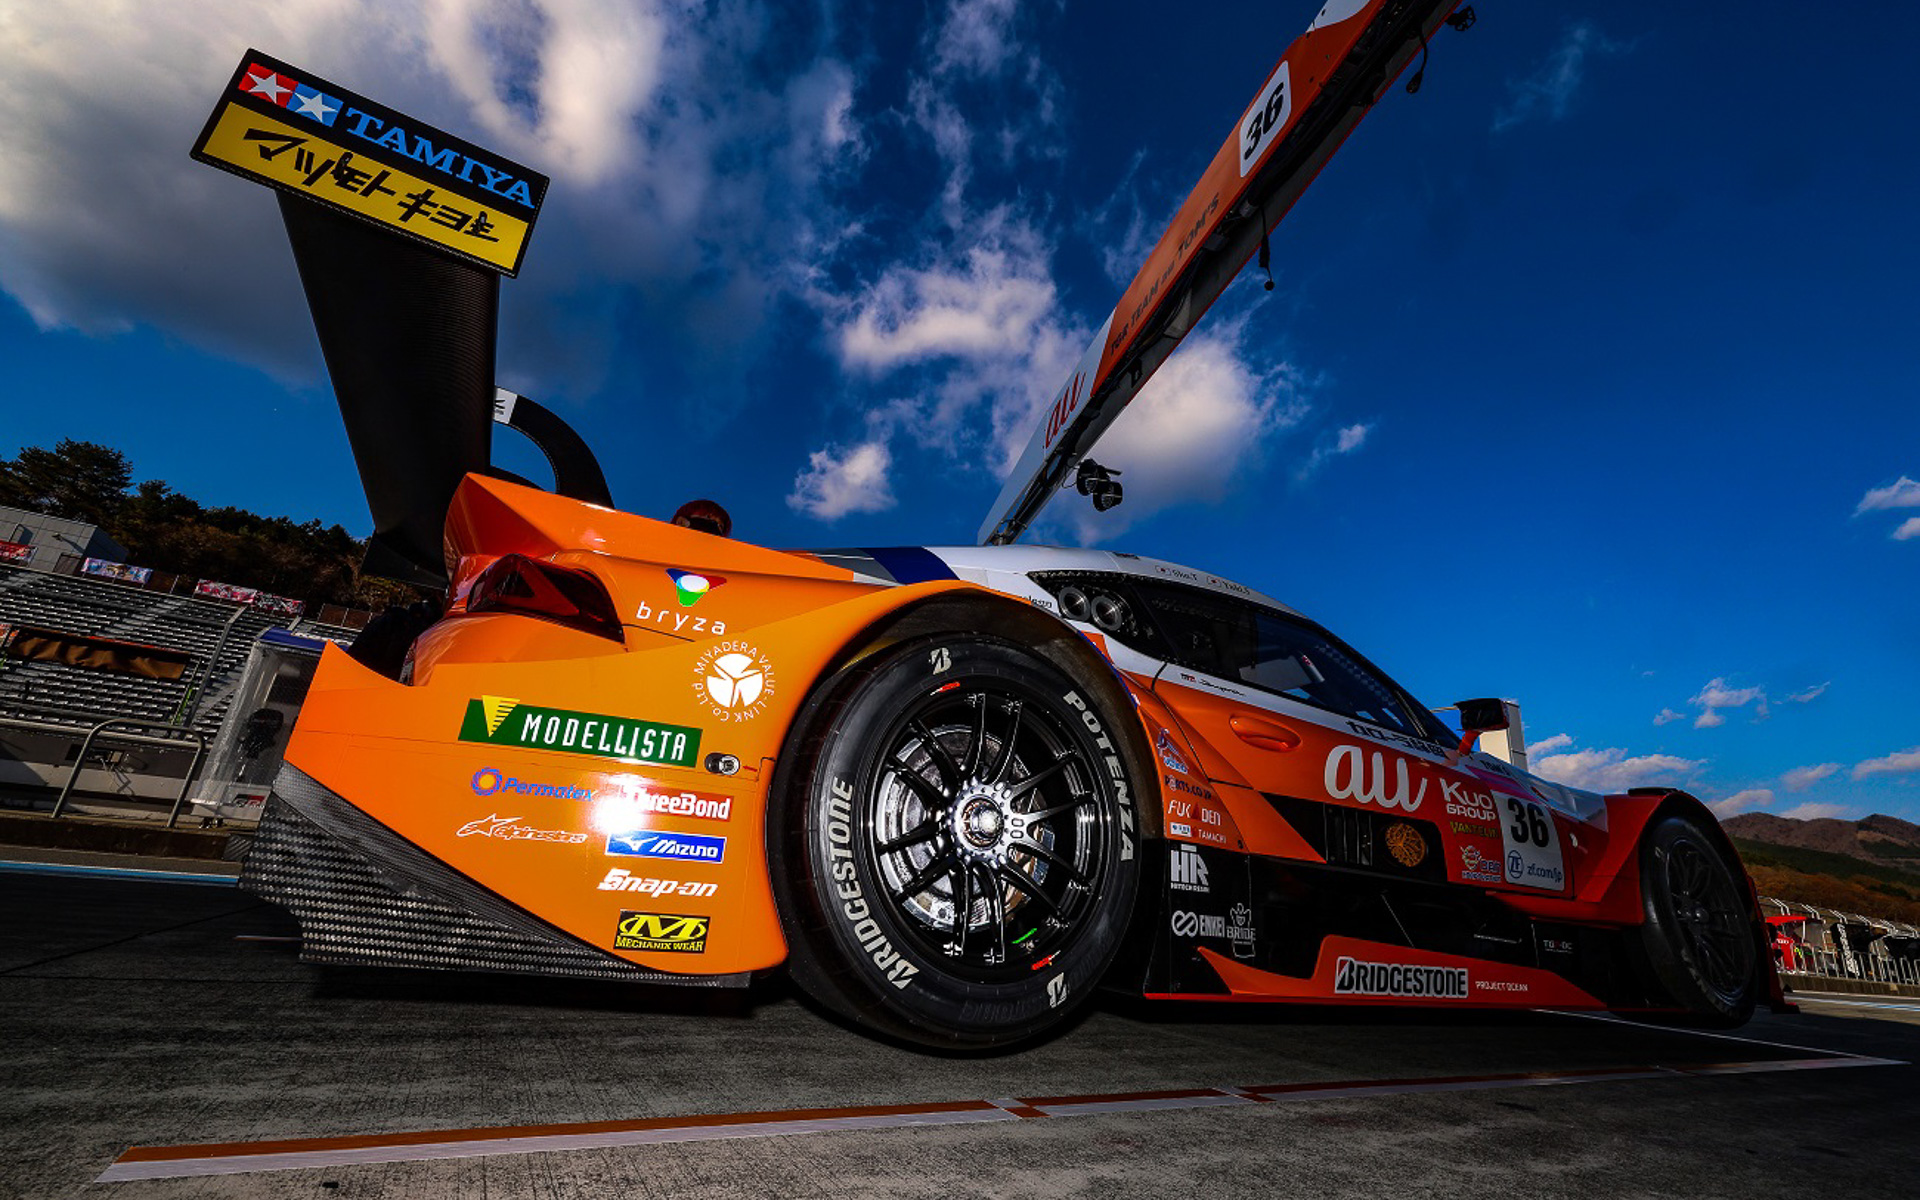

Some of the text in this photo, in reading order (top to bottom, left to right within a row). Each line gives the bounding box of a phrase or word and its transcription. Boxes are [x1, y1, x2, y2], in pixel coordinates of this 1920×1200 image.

[1243, 82, 1284, 160] 36
[345, 107, 536, 209] TAMIYA
[1130, 277, 1159, 327] TEAM
[1176, 192, 1220, 260] TOM'S
[1044, 371, 1087, 448] au
[635, 600, 727, 635] bryza
[693, 640, 757, 676] MIYADERA
[520, 713, 688, 762] MODELLISTA
[501, 777, 597, 802] Permatex
[1063, 690, 1134, 862] POTENZA
[1324, 744, 1428, 813] au
[623, 786, 731, 820] hreeBond
[1446, 803, 1496, 821] GROUP
[1507, 797, 1549, 848] 36
[597, 867, 719, 898] Snap-on
[827, 776, 920, 990] BRIDGESTONE
[615, 935, 704, 951] MECHANIX WEAR
[1226, 925, 1257, 941] BRIDE
[1336, 957, 1468, 997] BRIDGESTONE
[1475, 980, 1529, 992] PROJECT OCEAN
